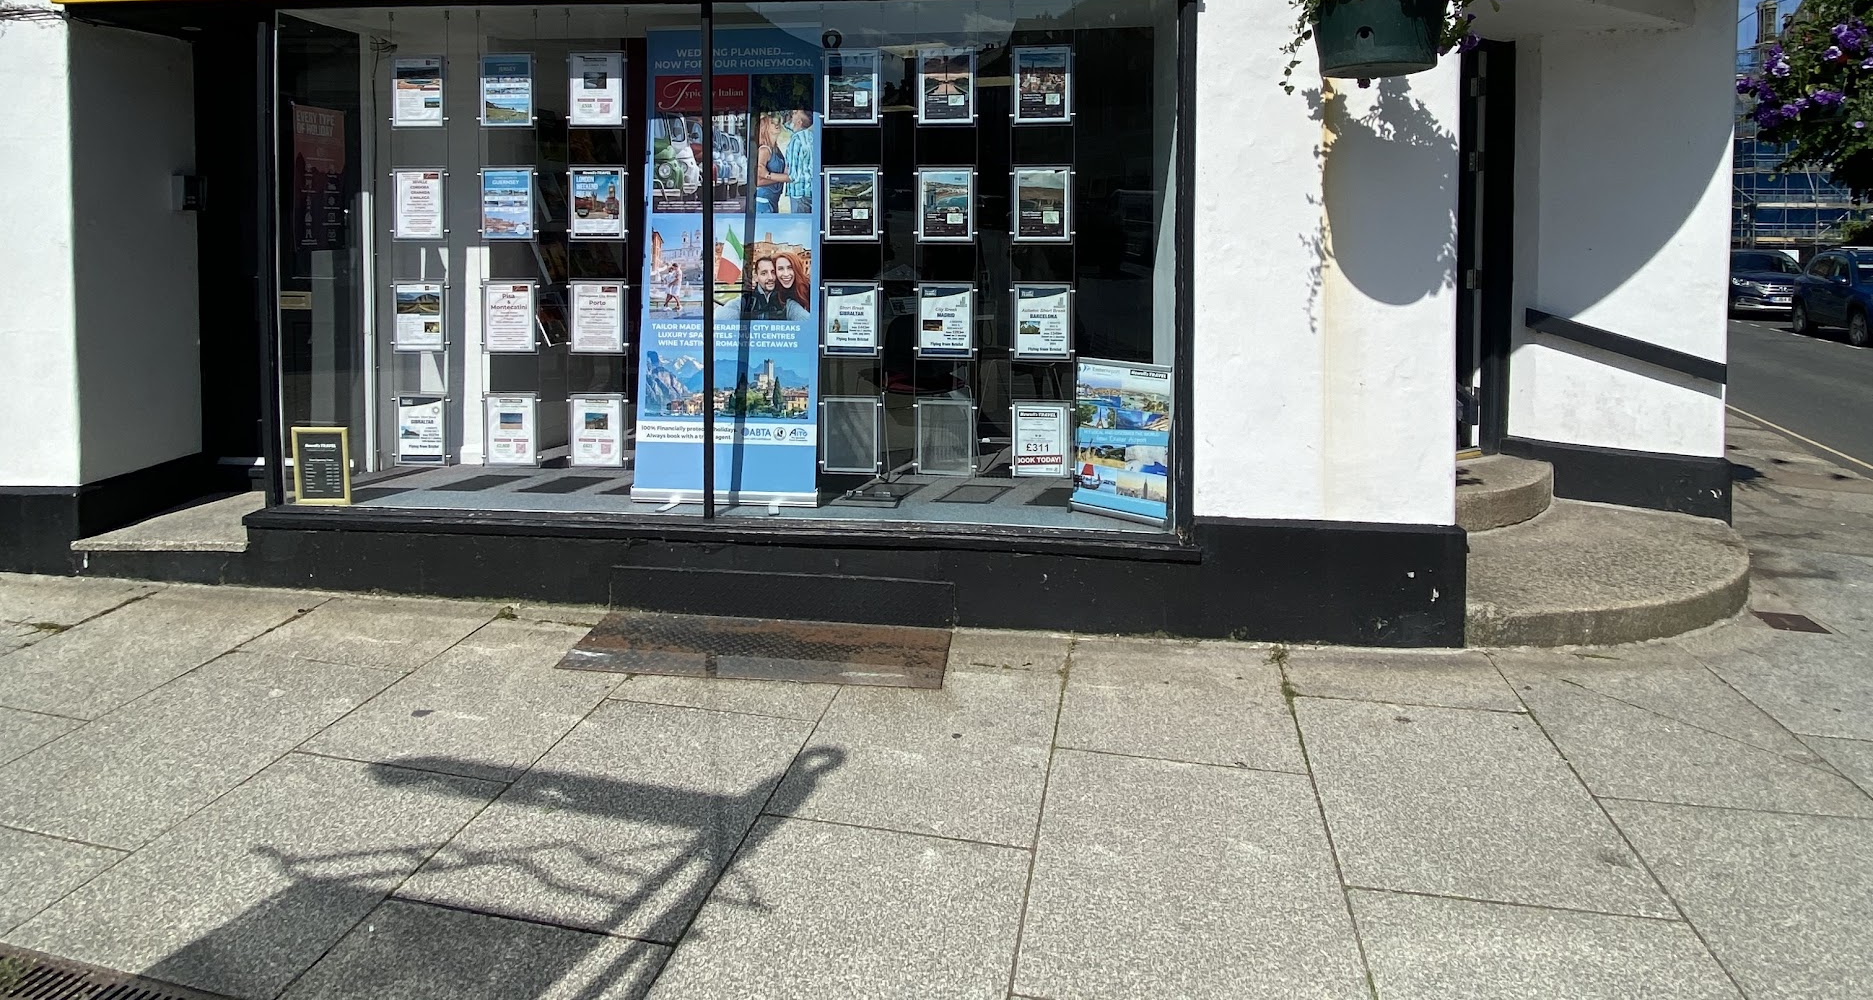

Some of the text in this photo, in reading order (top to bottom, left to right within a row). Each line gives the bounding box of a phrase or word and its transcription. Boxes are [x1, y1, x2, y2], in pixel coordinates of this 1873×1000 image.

[676, 48, 728, 58] WEDNG
[654, 60, 681, 69] NOW
[714, 59, 738, 68] OUR
[718, 87, 744, 97] Italian
[296, 110, 335, 126] EVERY TYPE
[306, 124, 334, 137] HOLIDAY
[770, 324, 801, 332] BREAKS
[749, 428, 772, 437] ABTA
[1025, 443, 1049, 452] £311
[1036, 456, 1062, 464] TODAY!
